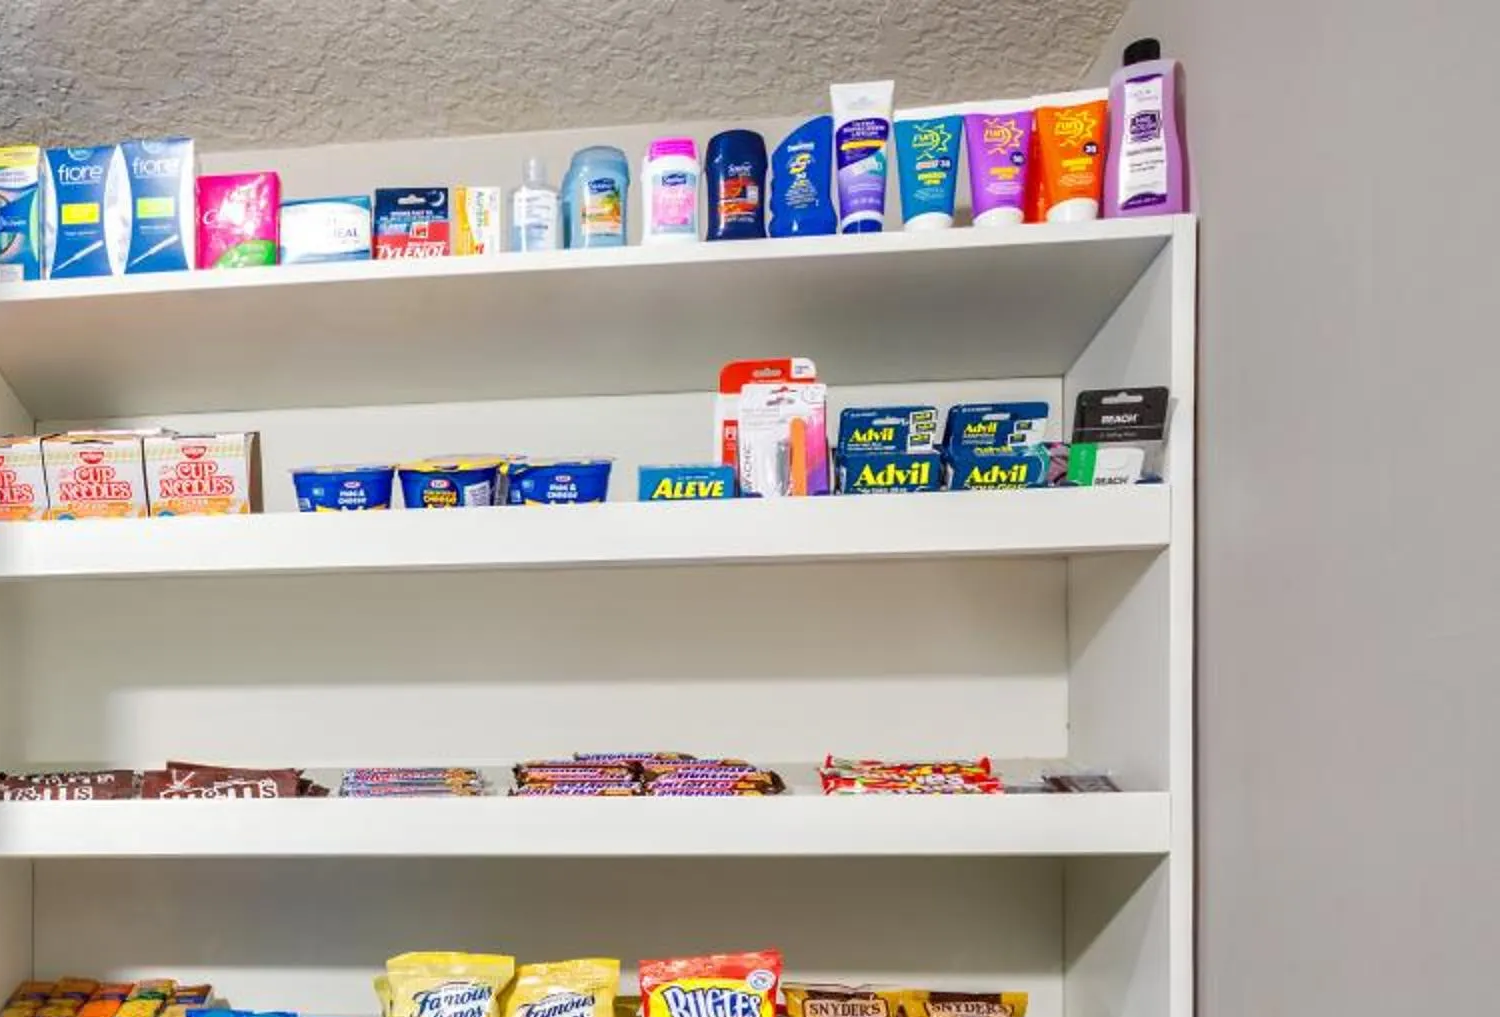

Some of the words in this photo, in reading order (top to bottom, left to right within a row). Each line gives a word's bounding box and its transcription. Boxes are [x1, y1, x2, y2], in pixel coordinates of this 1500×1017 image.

[58, 163, 104, 182] fiore
[132, 156, 181, 177] fiore
[848, 427, 894, 442] Advil
[964, 422, 997, 433] Advil
[74, 466, 115, 482] CUP
[176, 461, 218, 479] CUP
[852, 461, 931, 487] Advil
[967, 463, 1027, 483] Advil
[59, 481, 133, 500] NOODLES
[159, 476, 235, 499] NOODLES
[651, 478, 725, 499] ALEVE
